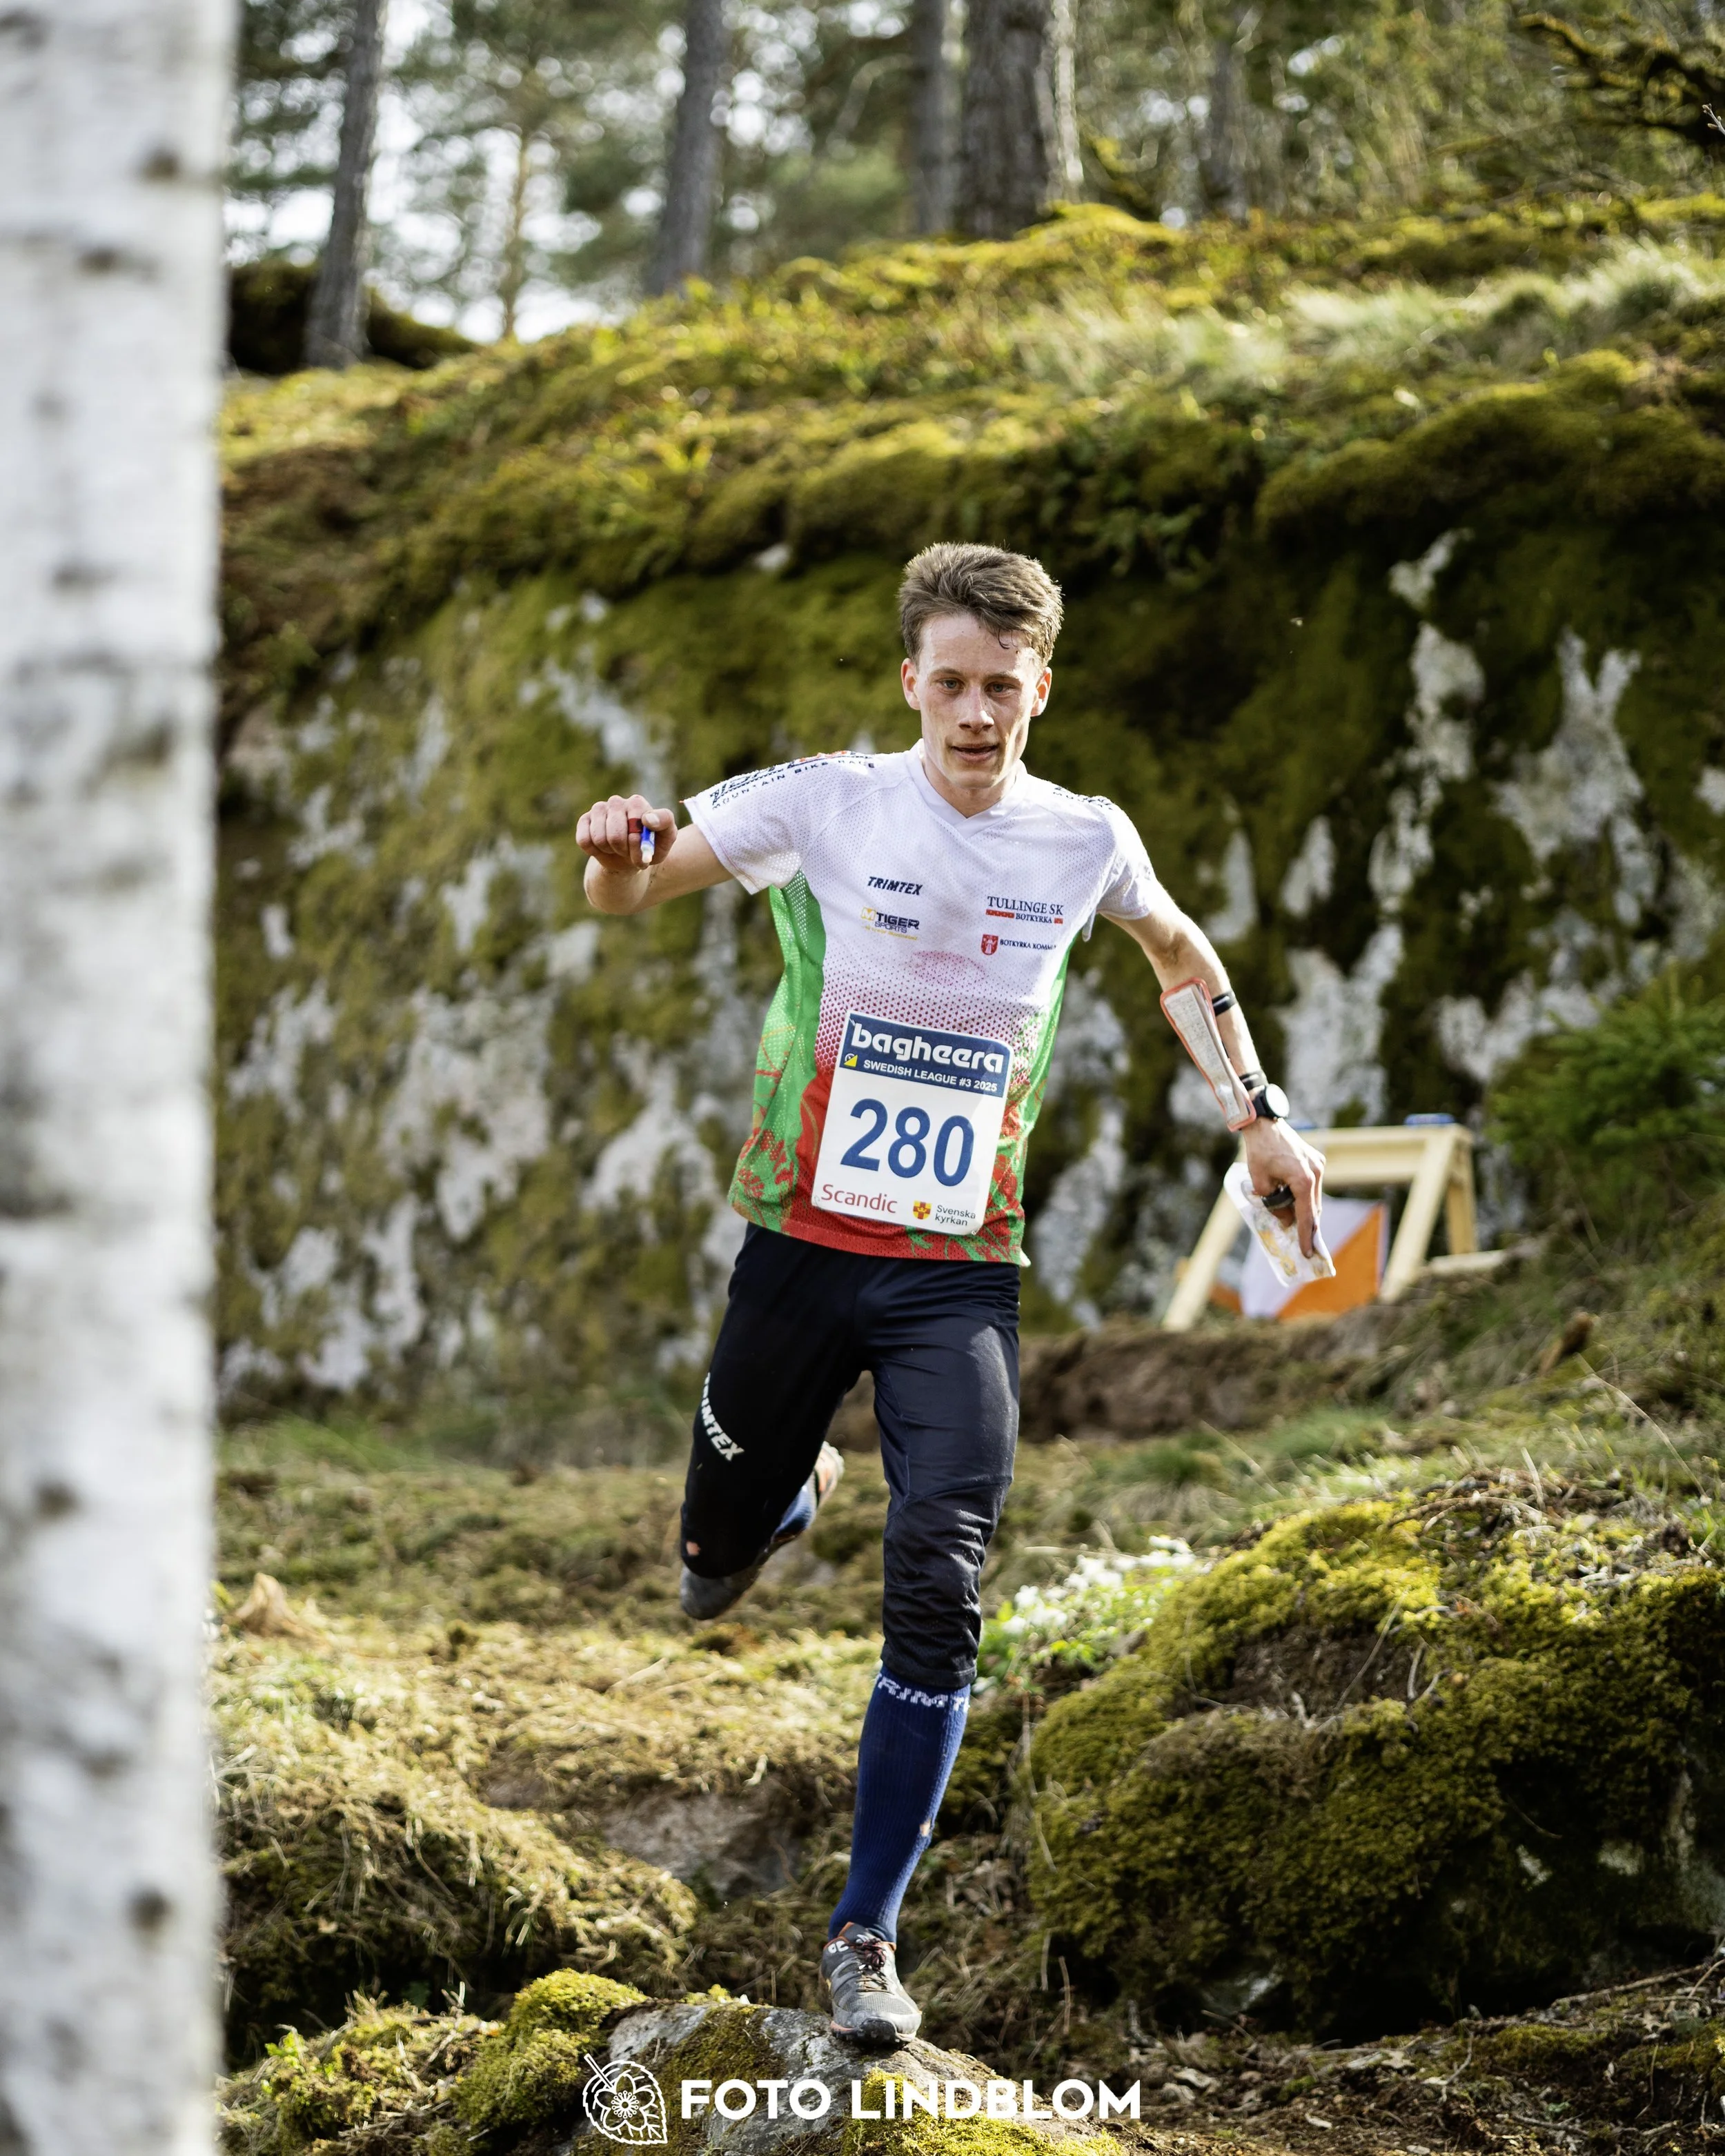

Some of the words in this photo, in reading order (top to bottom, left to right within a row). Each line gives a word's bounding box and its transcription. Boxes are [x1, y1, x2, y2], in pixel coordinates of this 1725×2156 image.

[712, 774, 785, 810] MOUNAIN
[794, 762, 829, 773] BIKE
[867, 876, 923, 896] TRIMTEX
[987, 896, 1047, 914] TULLINGE
[1049, 904, 1064, 916] SK
[874, 921, 907, 933] SPORTS
[876, 911, 920, 930] TIGER
[1016, 912, 1052, 924] BOTKYRKA
[1000, 939, 1031, 949] BOTKYRKA
[851, 1023, 1004, 1074] bagheera
[863, 1060, 912, 1077] SWEDISH
[914, 1071, 957, 1085] LEAGUE
[958, 1078, 972, 1087] #3
[974, 1080, 998, 1092] 2025
[840, 1098, 974, 1187] 280
[821, 1184, 898, 1214] Scandic
[935, 1213, 968, 1227] kyrkan
[936, 1205, 976, 1220] Svenska
